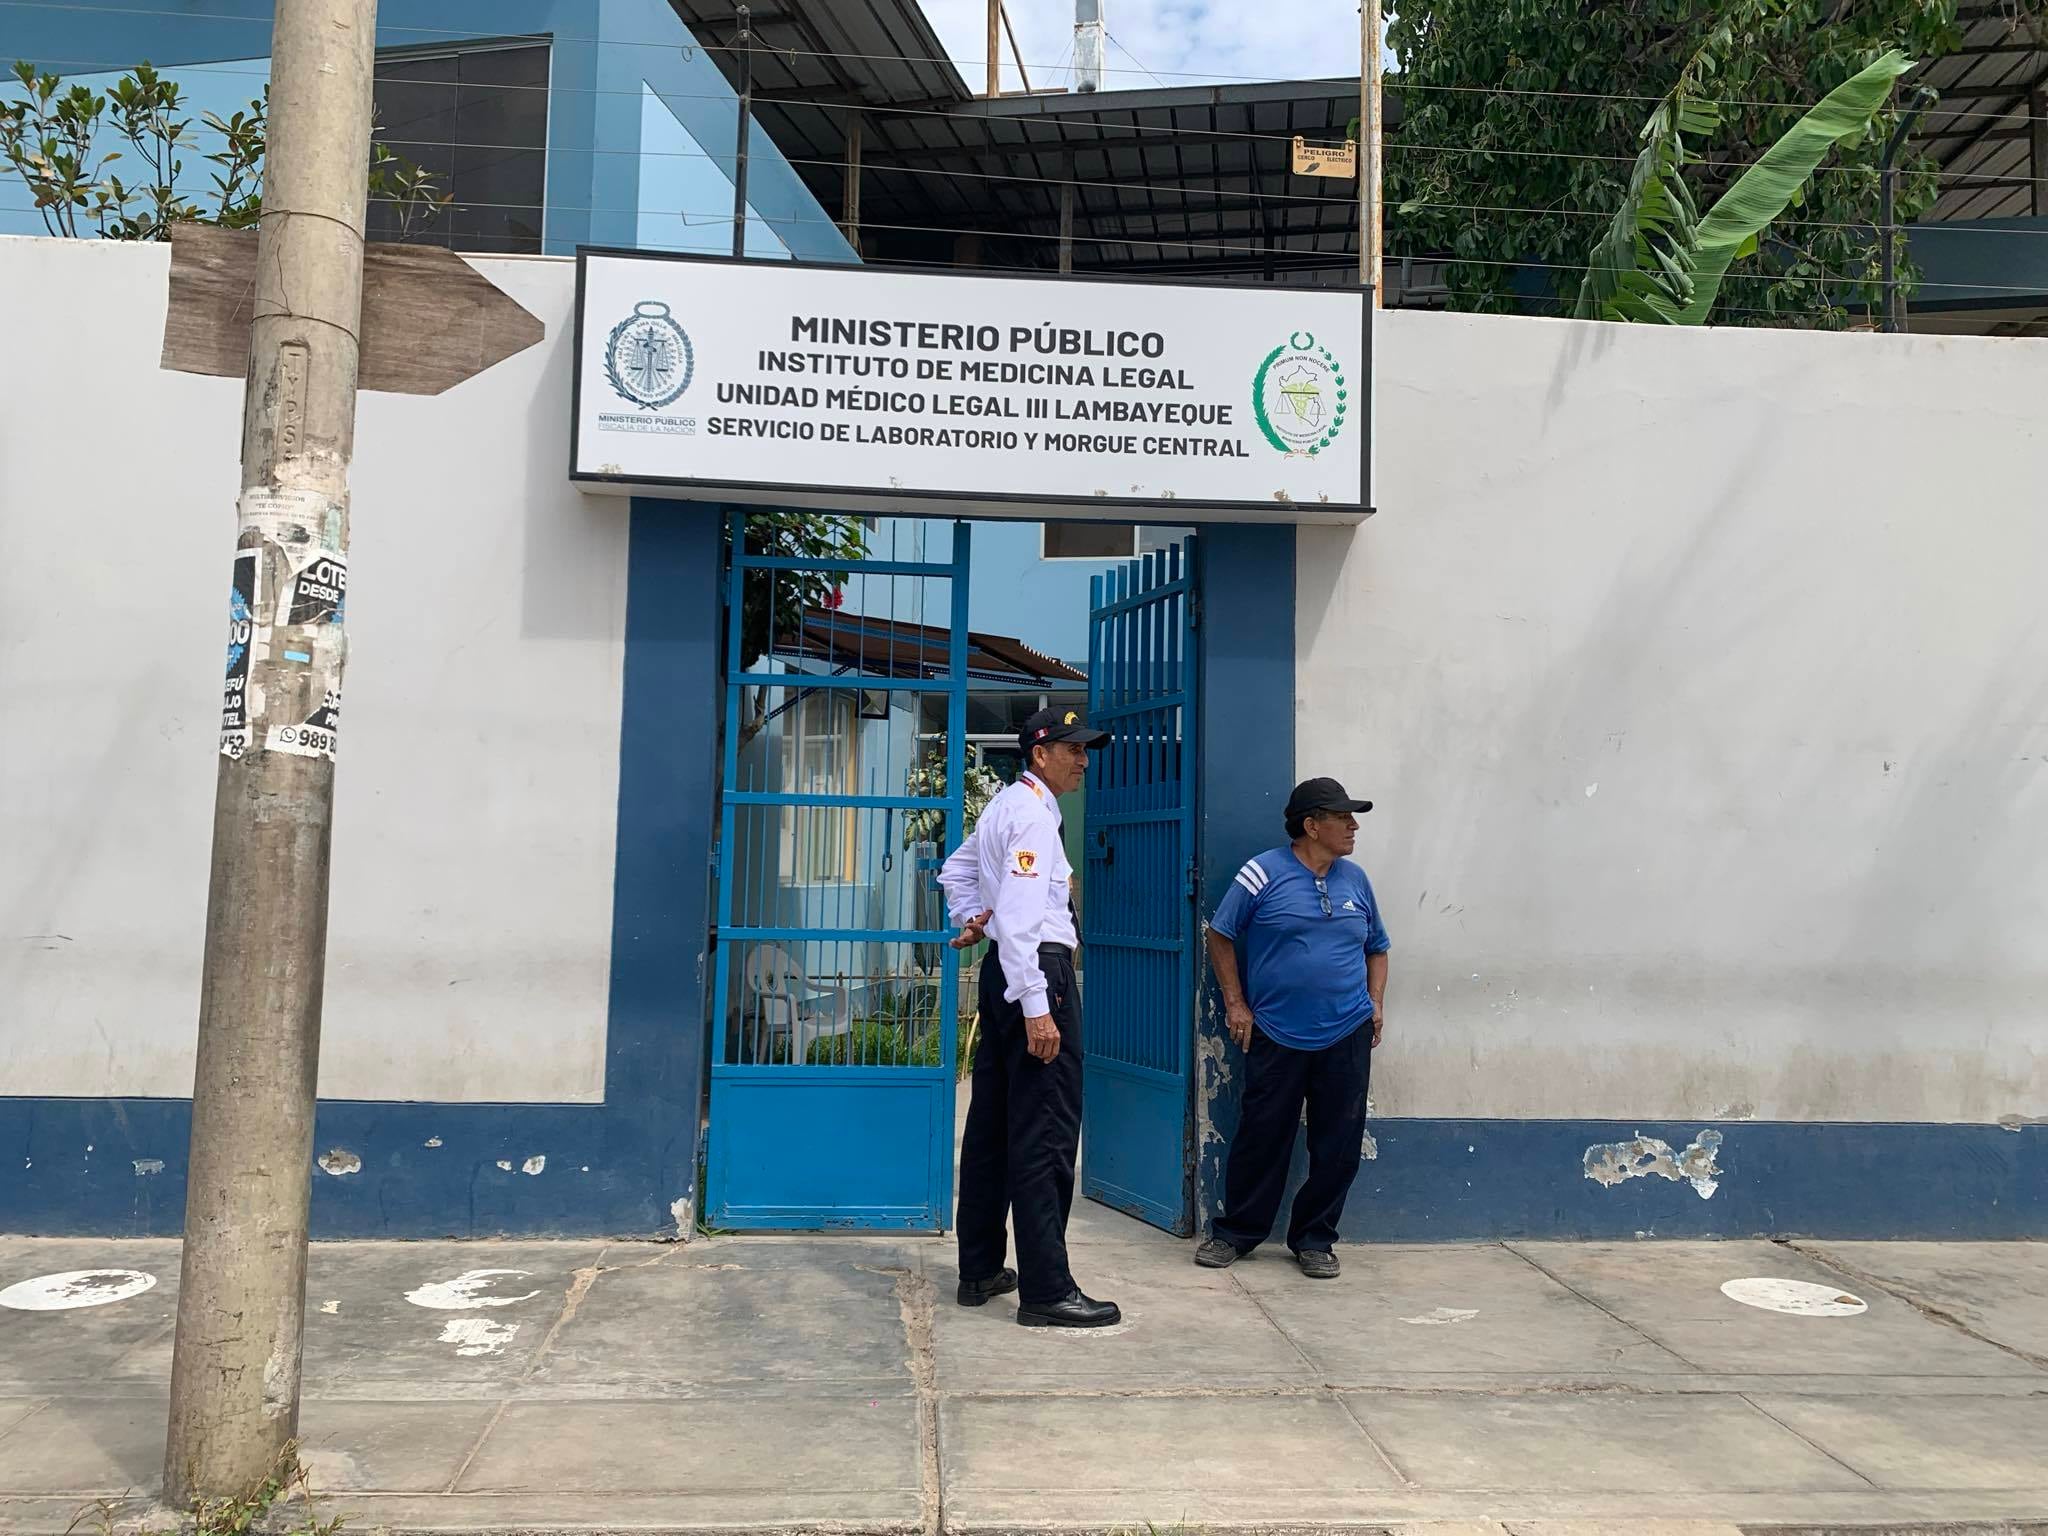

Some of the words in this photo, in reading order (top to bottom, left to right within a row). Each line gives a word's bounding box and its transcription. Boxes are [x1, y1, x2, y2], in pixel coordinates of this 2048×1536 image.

[1303, 148, 1345, 157] PELIGRO
[791, 316, 1000, 353] MINISTERIO
[1009, 321, 1164, 359] PÚBLICO
[758, 350, 909, 379] INSTITUTO
[916, 359, 953, 381] DE
[960, 361, 1095, 387] MEDICINA
[1102, 366, 1195, 390] LEGAL
[1272, 356, 1294, 370] PRIMUM
[1308, 356, 1331, 373] NOCERE
[717, 382, 819, 409] UNIDAD
[826, 384, 925, 414] MÉDICO
[932, 394, 1020, 418] LEGAL
[1026, 398, 1048, 419] III
[1055, 399, 1233, 427] LAMBAYEQUE
[598, 415, 653, 425] MINISTERIO
[707, 416, 814, 441] SERVICIO
[820, 423, 850, 443] DE
[856, 424, 1018, 450] LABORATORIO
[1023, 432, 1039, 450] Y
[1044, 432, 1138, 454] MORGUE
[1142, 436, 1250, 458] CENTRAL
[298, 581, 340, 603] DESDE
[298, 729, 328, 750] 989
